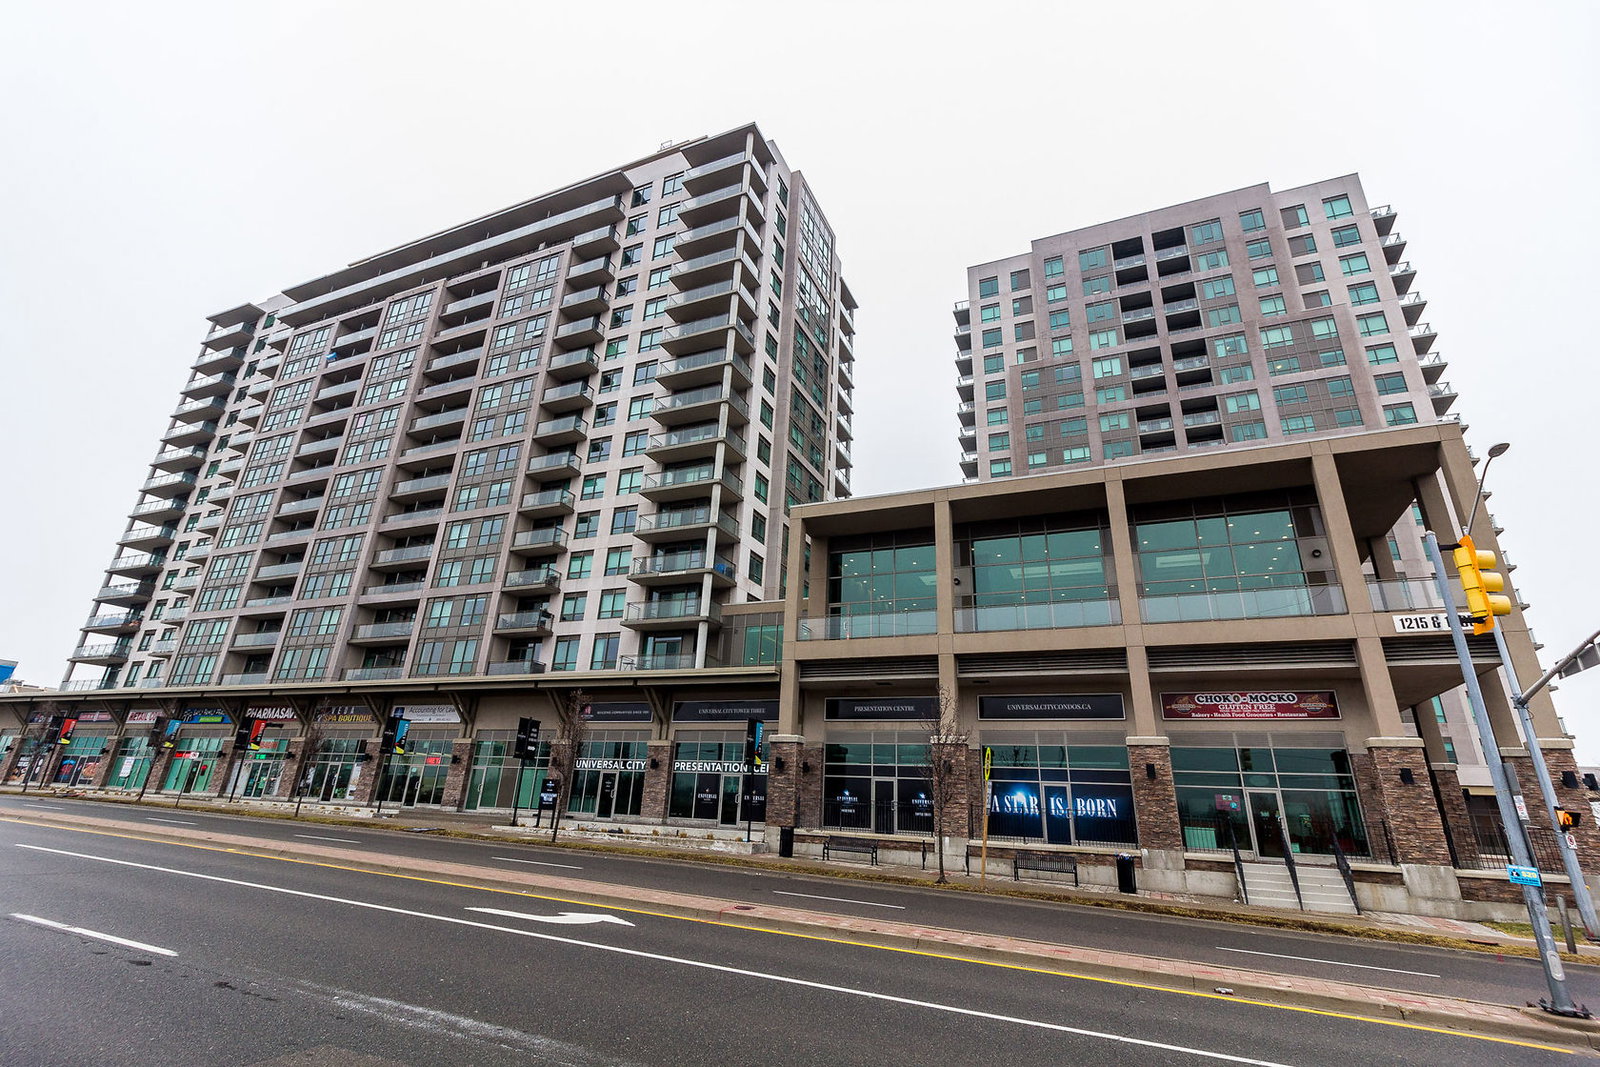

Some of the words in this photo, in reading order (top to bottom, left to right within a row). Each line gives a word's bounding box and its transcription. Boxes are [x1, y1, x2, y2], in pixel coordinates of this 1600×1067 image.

[1399, 616, 1428, 629] 1215
[1431, 615, 1441, 628] &
[1007, 703, 1092, 711] UNIVERSALCITYCONDOS.CA
[338, 714, 372, 722] BOUTIQUE
[575, 760, 625, 769] UNIVERSAL
[626, 761, 646, 770] CITY
[674, 762, 748, 772] PRESENTATION
[991, 795, 1000, 813] A
[1004, 794, 1040, 816] STAR
[1049, 797, 1065, 816] IS
[1075, 797, 1118, 818] BORN
